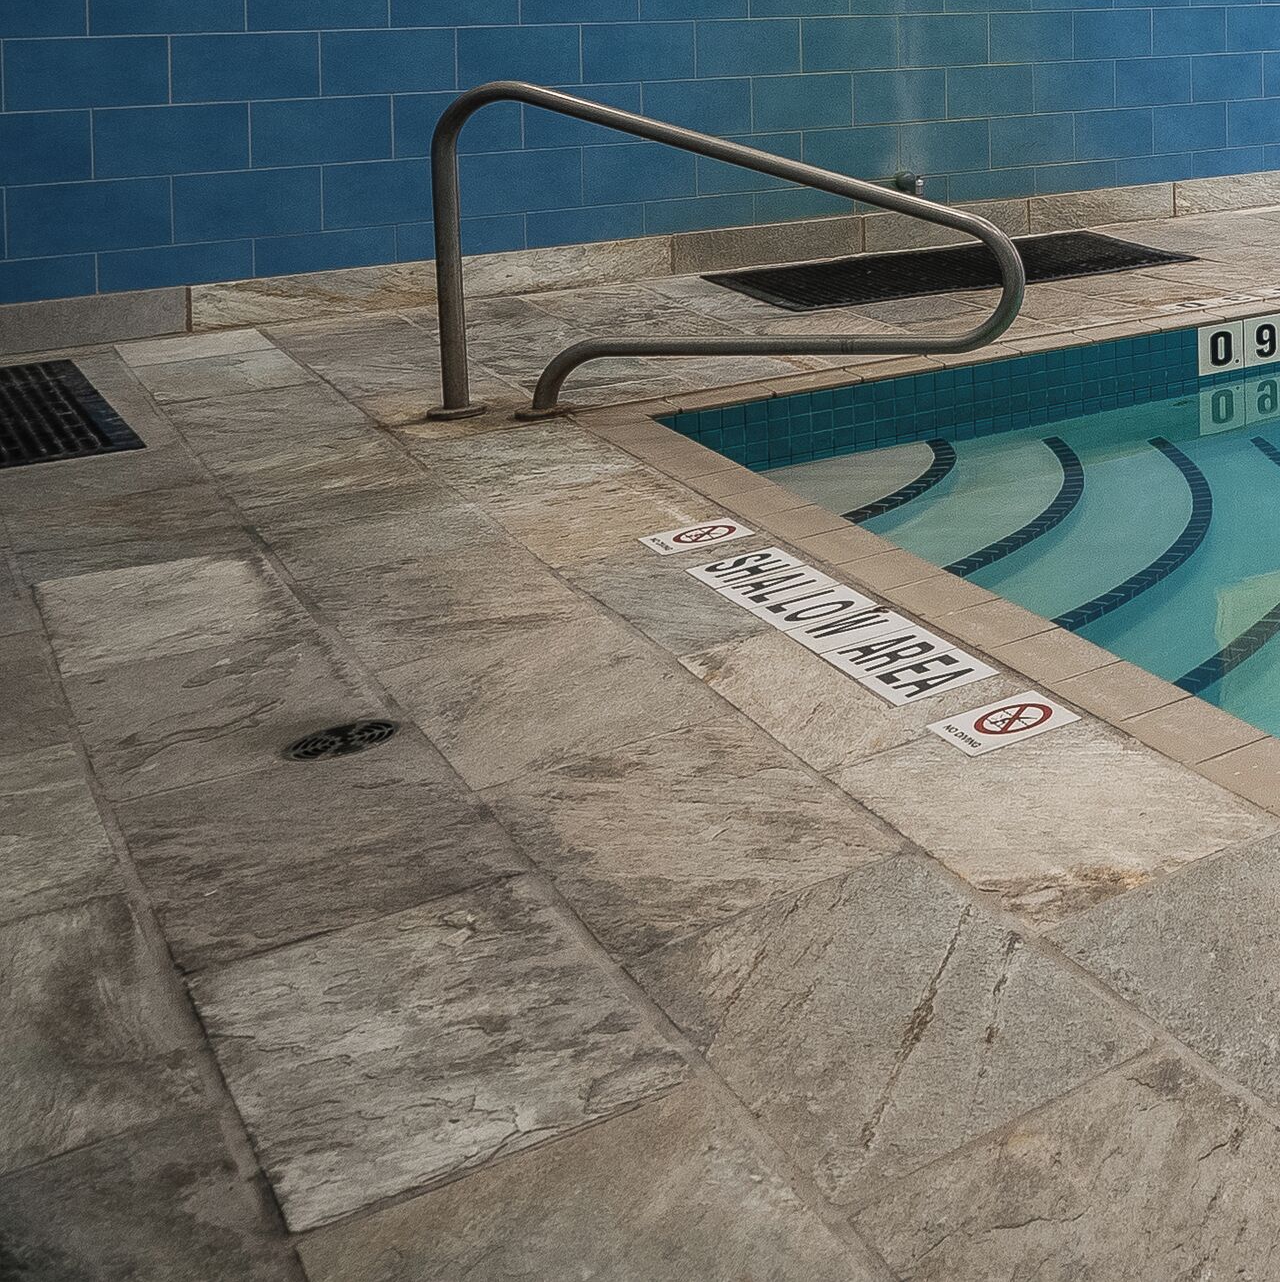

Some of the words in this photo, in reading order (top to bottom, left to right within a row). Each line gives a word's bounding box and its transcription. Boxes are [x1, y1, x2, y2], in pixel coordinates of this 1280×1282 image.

[705, 552, 890, 639] SHALLOW
[837, 634, 974, 699] AREA
[943, 724, 959, 734] NO
[954, 731, 982, 749] DIVING
